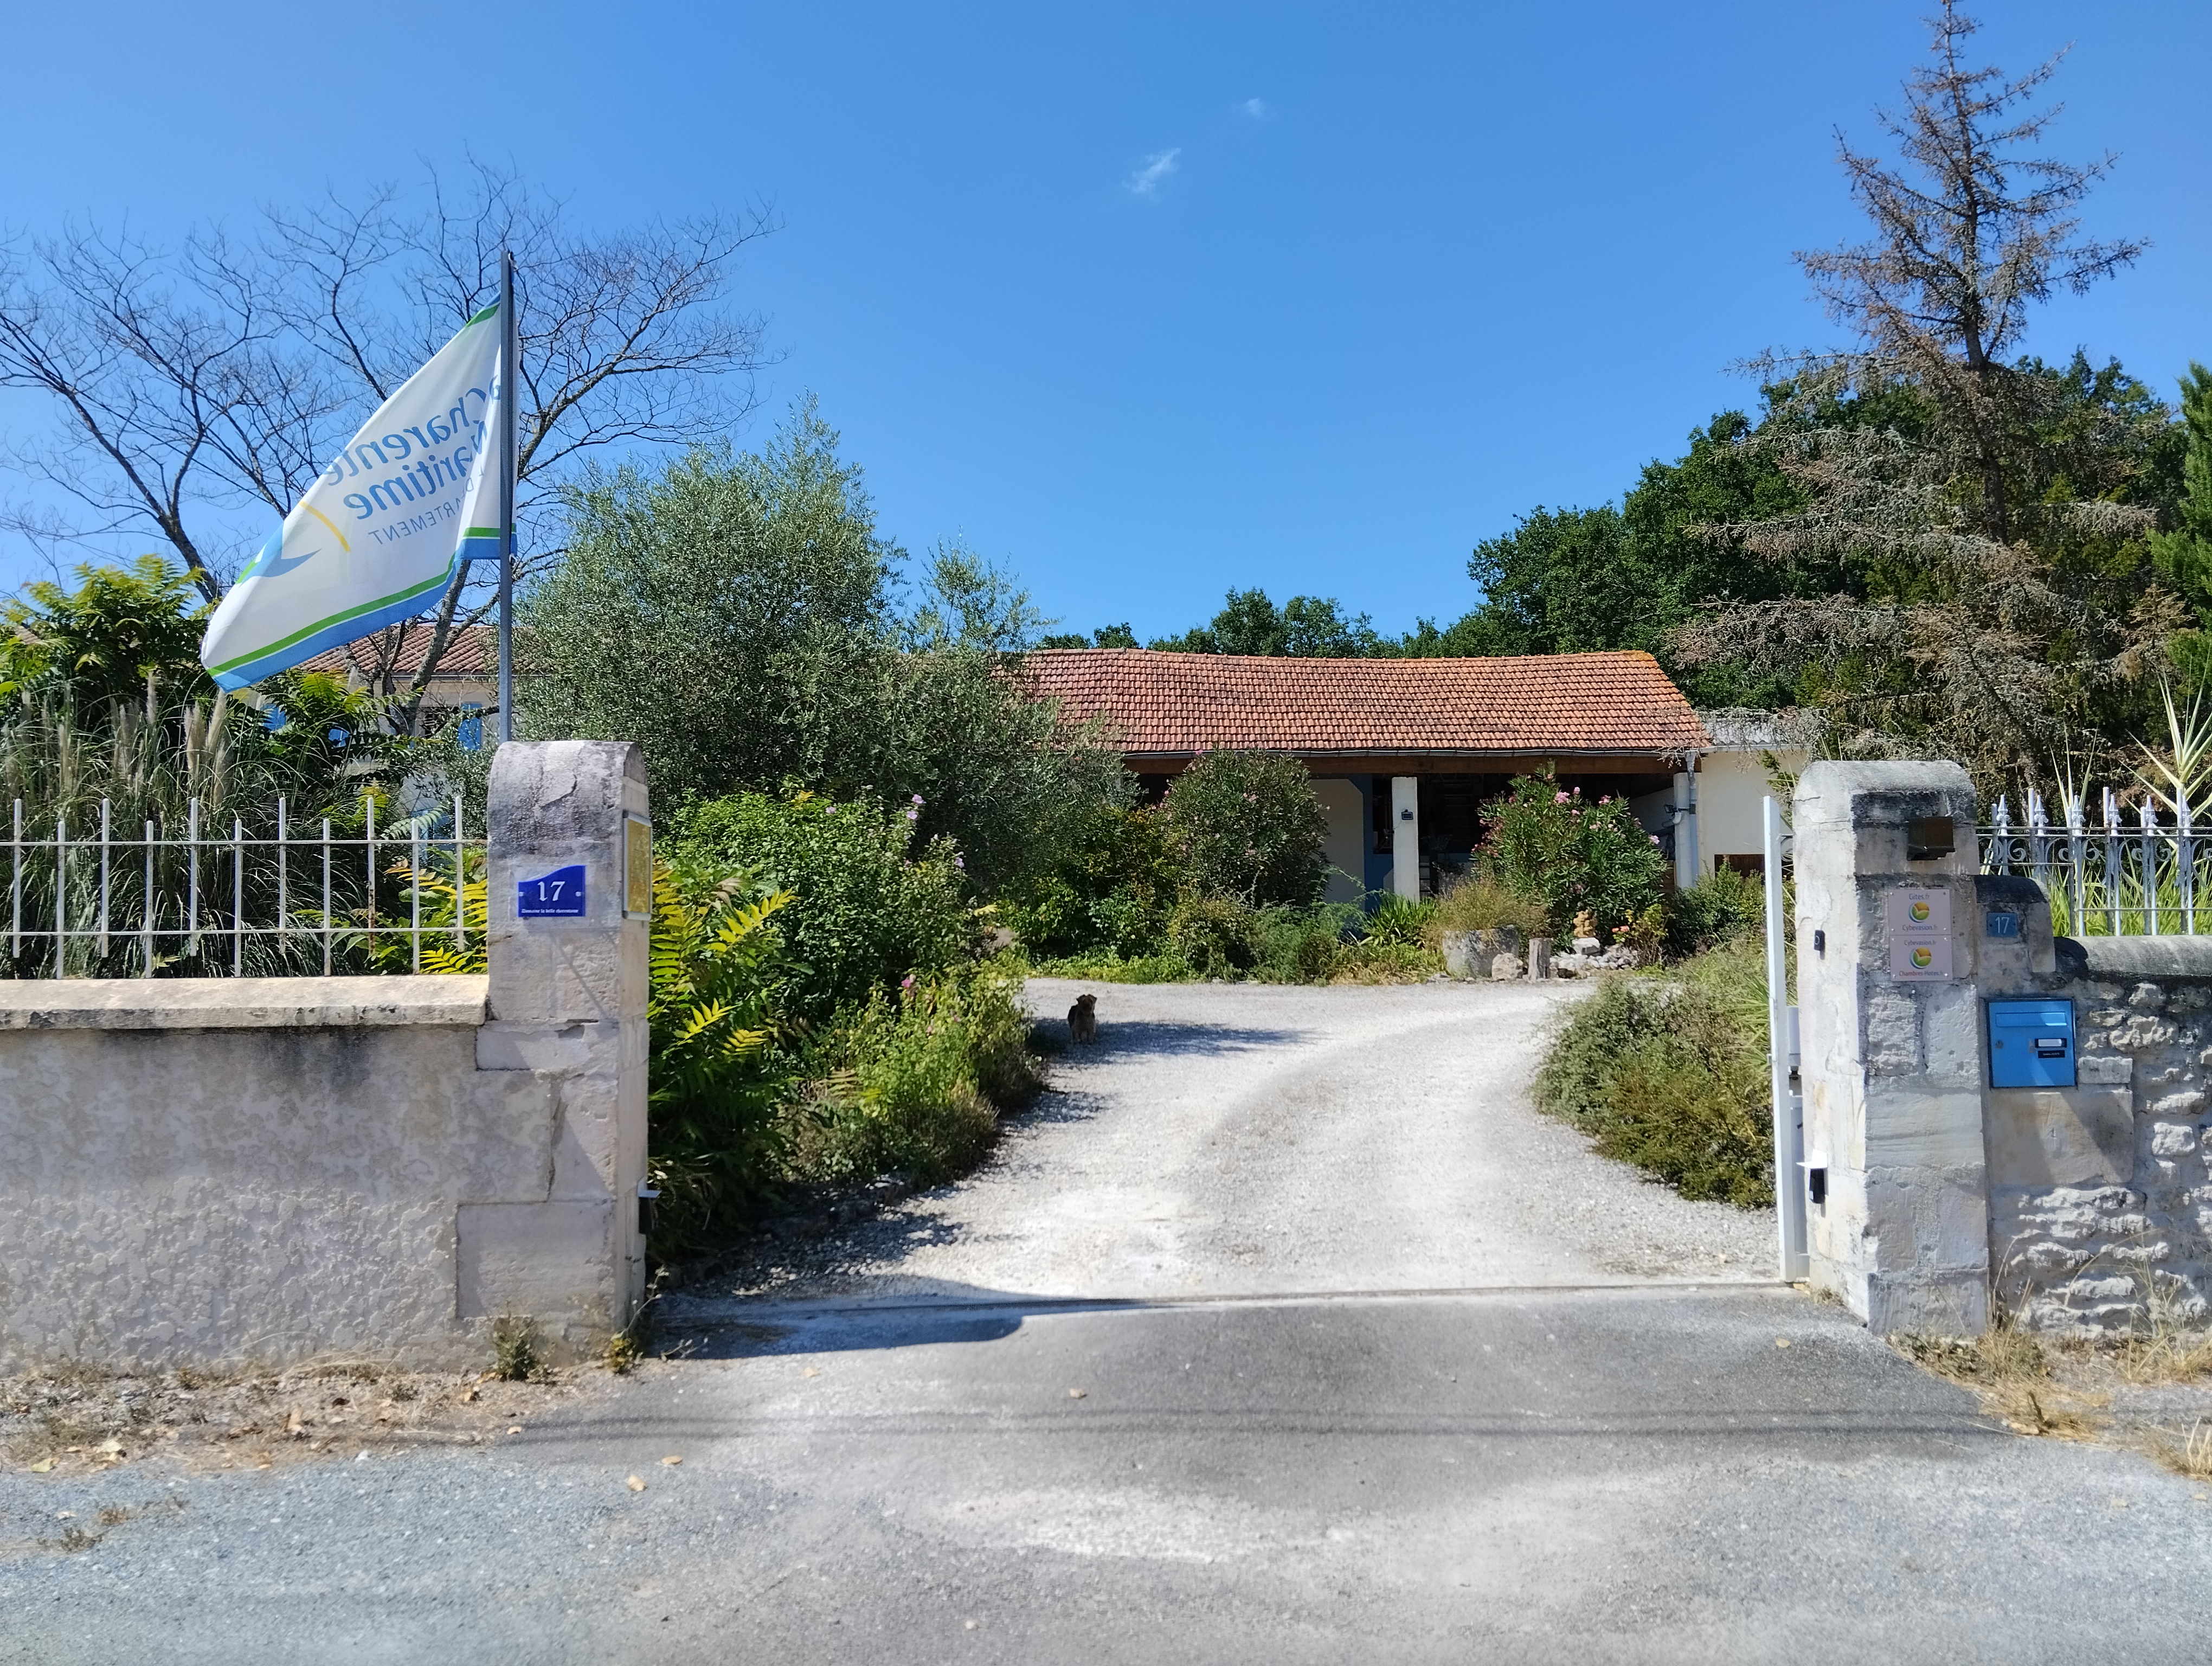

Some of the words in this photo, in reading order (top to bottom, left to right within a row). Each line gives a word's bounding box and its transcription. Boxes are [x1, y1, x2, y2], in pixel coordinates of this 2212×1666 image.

[537, 881, 565, 901] 17
[1902, 924, 1938, 932] Cybevasion.fr
[1995, 917, 2010, 933] 17
